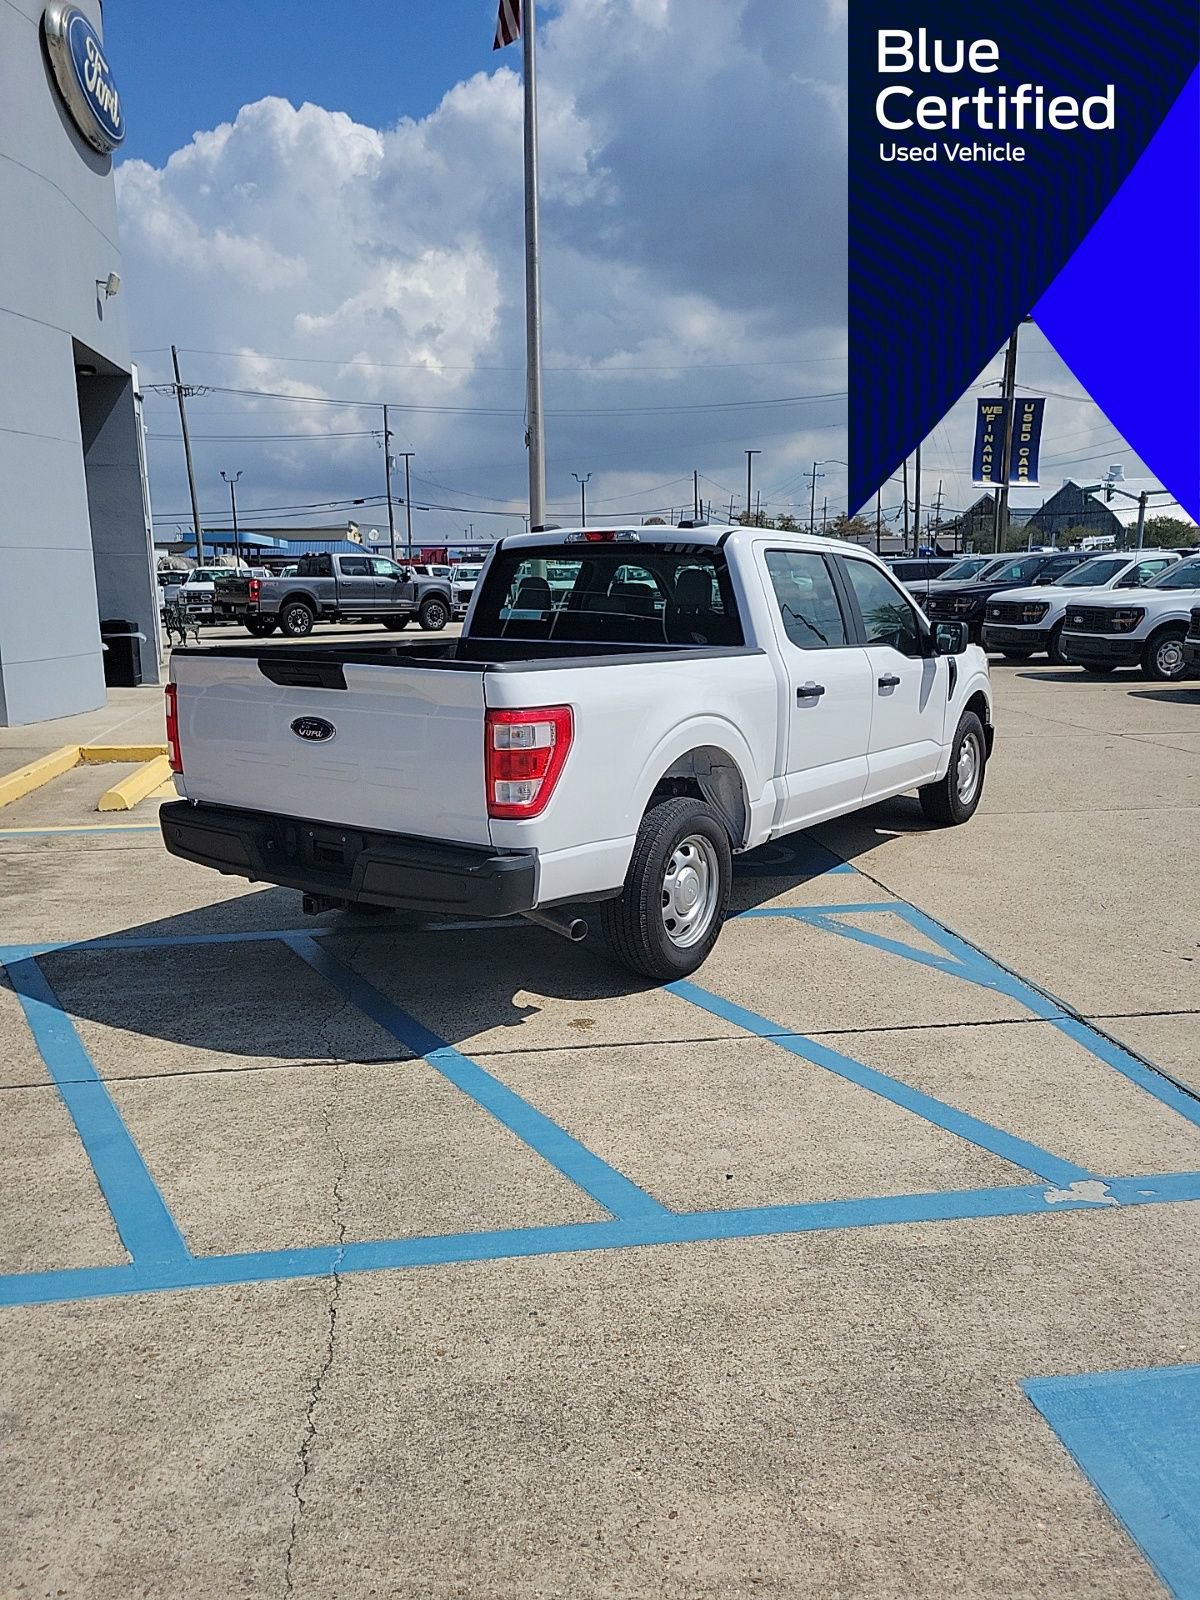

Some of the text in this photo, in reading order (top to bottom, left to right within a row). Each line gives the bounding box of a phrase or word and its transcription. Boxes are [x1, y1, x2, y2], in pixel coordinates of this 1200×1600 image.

[84, 36, 120, 128] Ford
[981, 406, 1003, 414] WE
[1018, 403, 1034, 483] USED CARS
[981, 414, 995, 483] FINANCE
[299, 721, 324, 737] Ford
